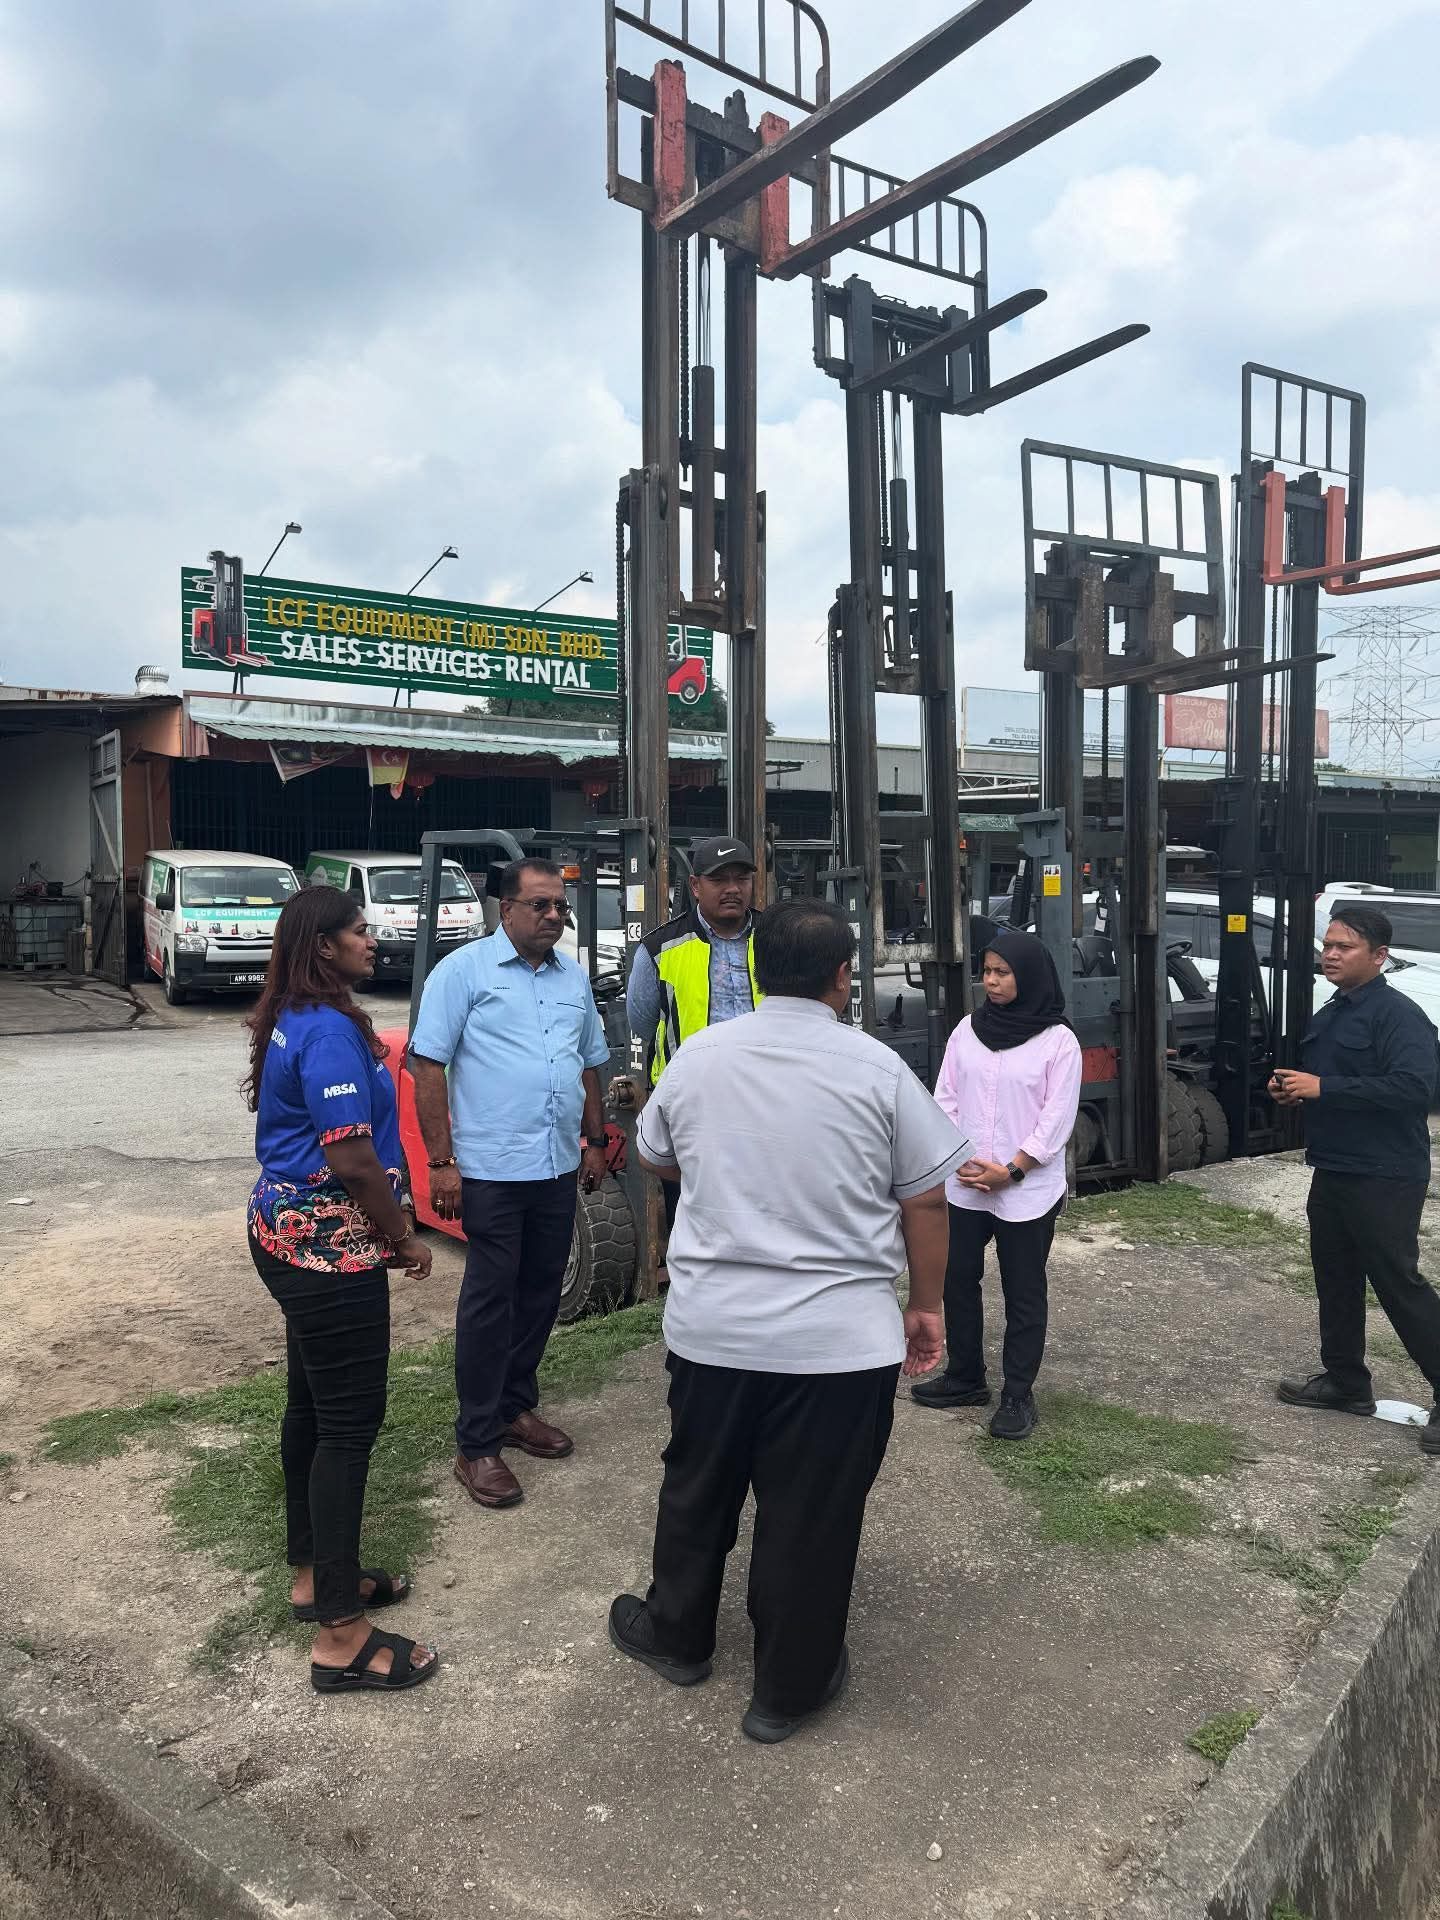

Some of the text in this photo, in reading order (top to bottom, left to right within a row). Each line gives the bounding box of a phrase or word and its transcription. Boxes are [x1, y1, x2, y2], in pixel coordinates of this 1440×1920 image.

[267, 595, 607, 660] LCF EQUIPMENT (M) SDN. BHD.
[505, 655, 591, 689] RENTAL
[323, 1082, 358, 1099] MBSA
